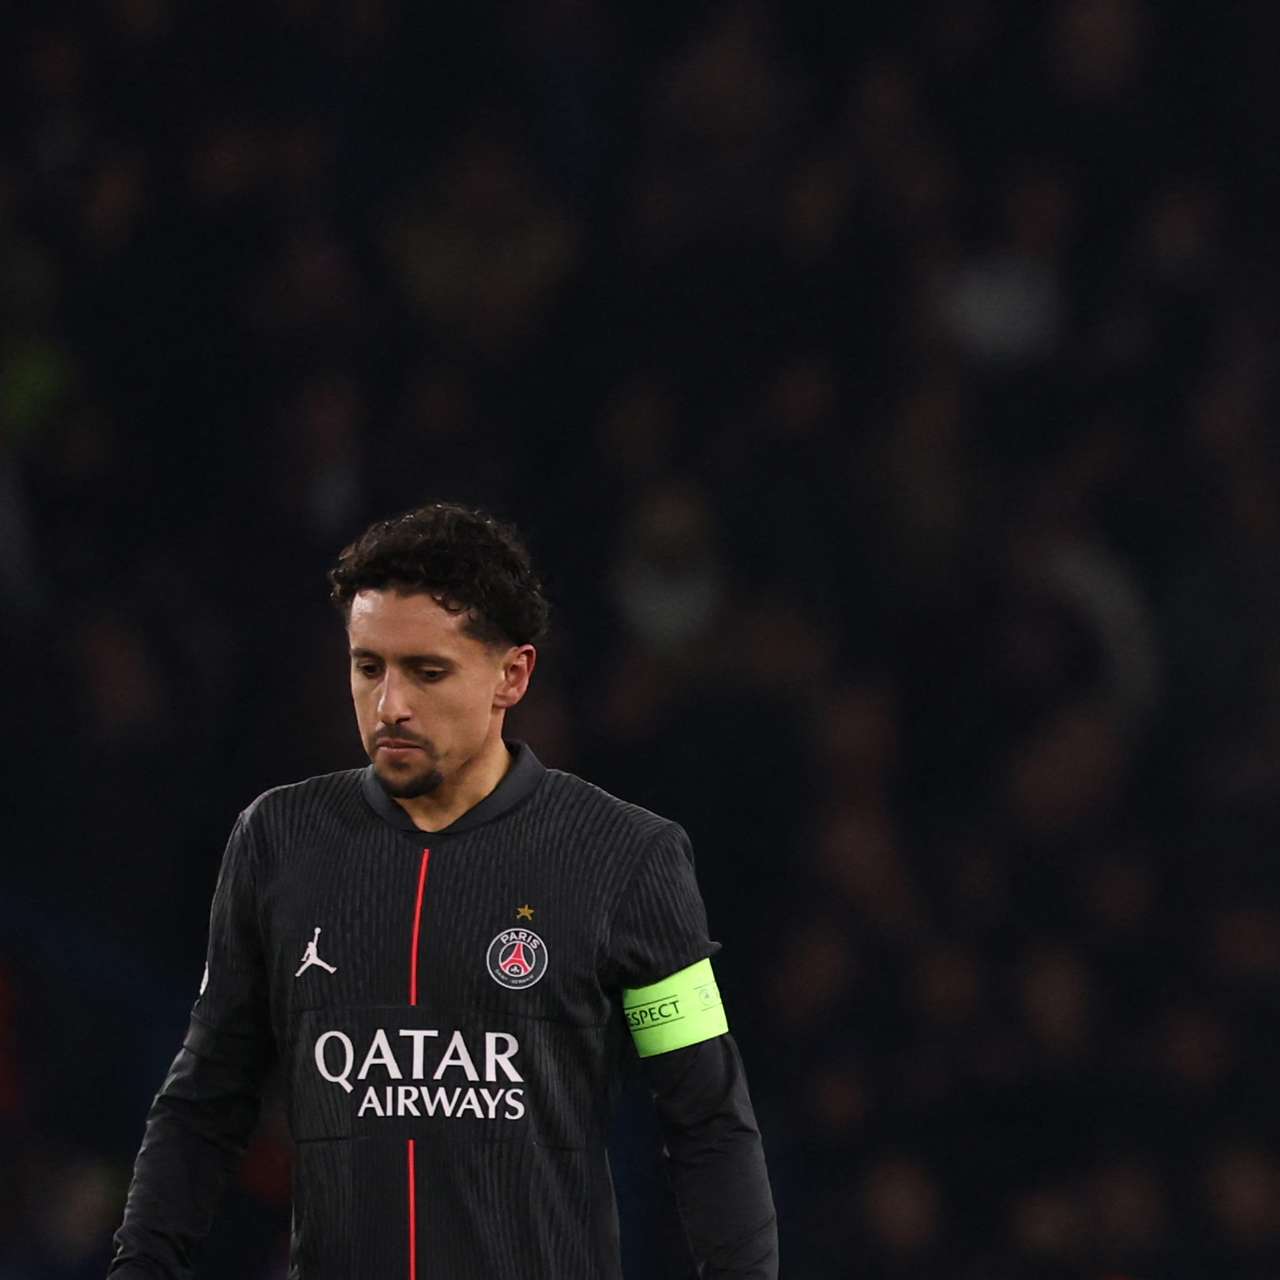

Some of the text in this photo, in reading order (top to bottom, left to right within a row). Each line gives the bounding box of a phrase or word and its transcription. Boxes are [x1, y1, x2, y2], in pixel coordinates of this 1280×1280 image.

[500, 932, 540, 949] PARIS
[314, 1028, 524, 1093] QATAR
[356, 1085, 525, 1120] AIRWAYS
